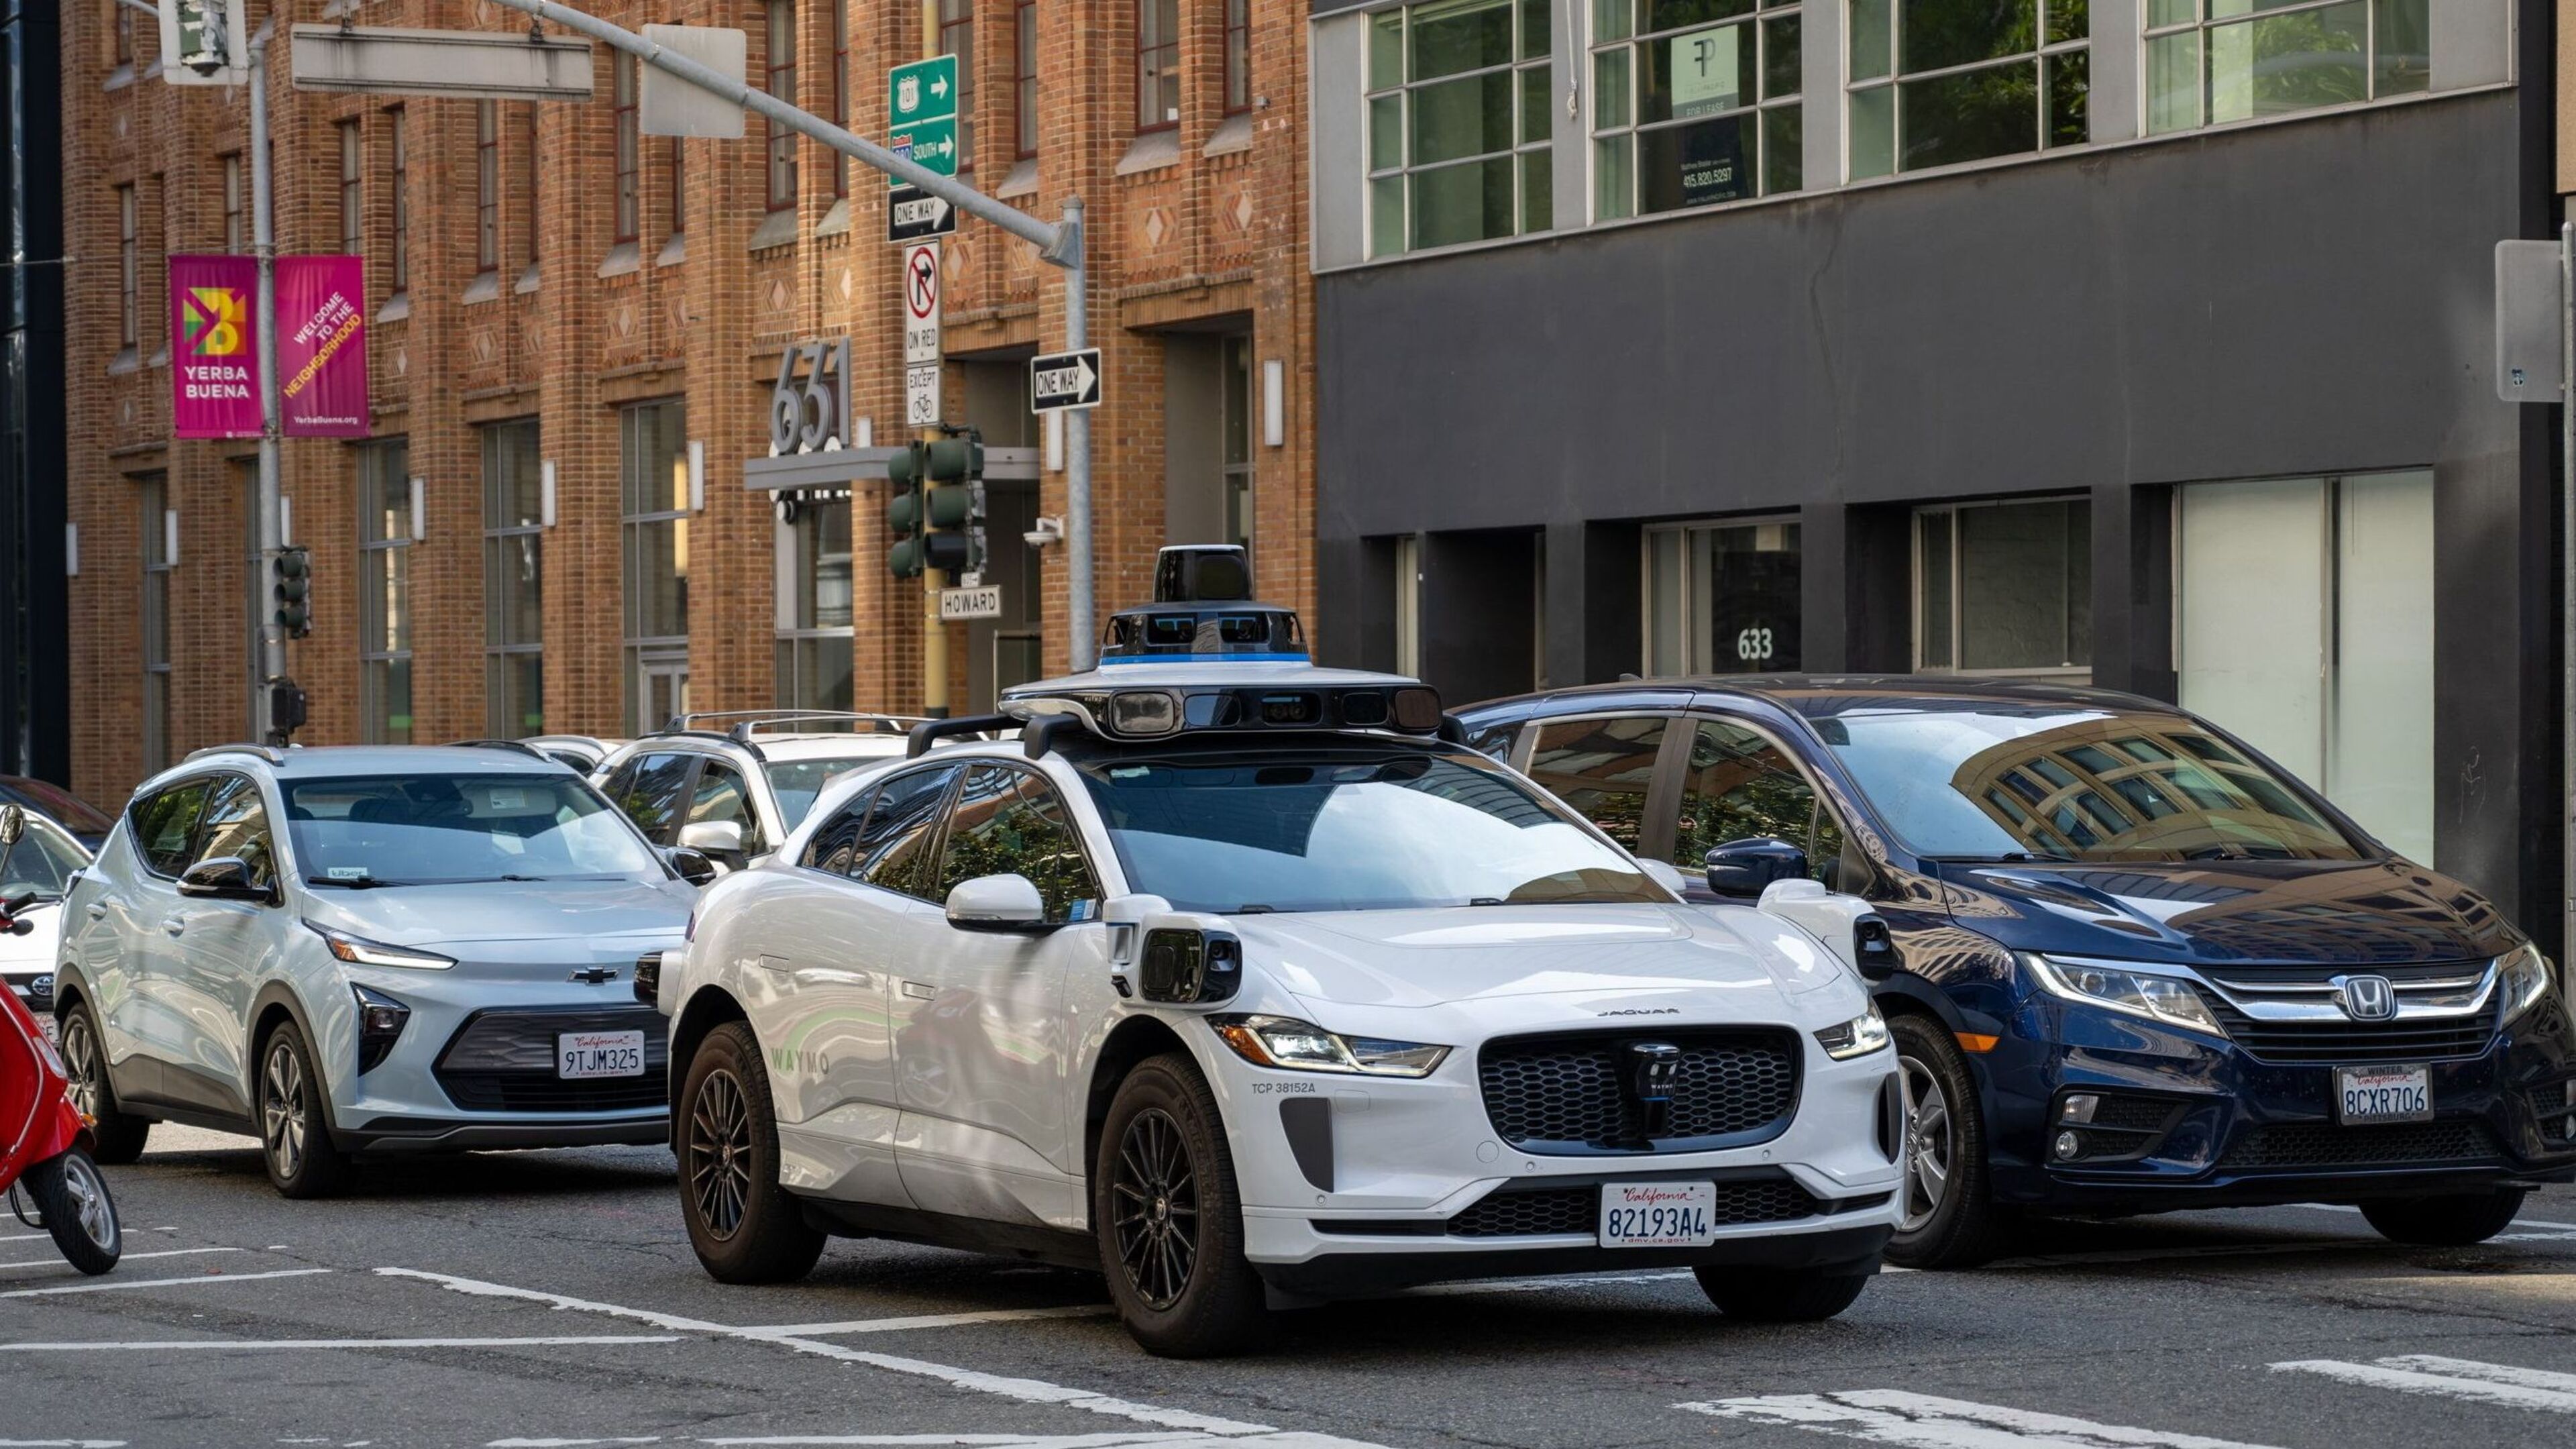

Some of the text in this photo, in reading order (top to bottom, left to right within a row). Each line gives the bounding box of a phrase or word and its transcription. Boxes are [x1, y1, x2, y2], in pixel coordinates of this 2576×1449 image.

[902, 87, 914, 103] 101
[914, 142, 937, 160] SOUTH
[1683, 167, 1732, 188] 415.820.5297
[896, 199, 936, 223] ONE WAY
[293, 291, 344, 345] WELCOME
[317, 301, 354, 341] TO THE
[908, 328, 936, 350] ON RED
[283, 313, 362, 398] NEIGHBORHOOD
[184, 366, 249, 380] YERBA
[909, 371, 936, 388] EXCEPT
[1037, 368, 1079, 395] ONE WAY
[185, 384, 250, 398] BUENA
[771, 336, 851, 455] 631
[294, 415, 358, 425] YerbaBuena.org
[945, 592, 996, 613] HOWARD
[1738, 628, 1772, 659] 633
[1597, 1008, 1680, 1017] JAGUAR
[577, 1036, 629, 1049] California
[566, 1049, 639, 1072] 9TJM325
[771, 1048, 830, 1075] WAYMO
[2367, 1066, 2403, 1075] WINTER
[1252, 1083, 1316, 1094] TCP 38152A
[2357, 1074, 2413, 1087] California
[2345, 1086, 2425, 1115] 8CXR706
[2363, 1112, 2411, 1122] PITTSBURG
[1626, 1187, 1694, 1206] California
[1609, 1207, 1707, 1238] 82193A4
